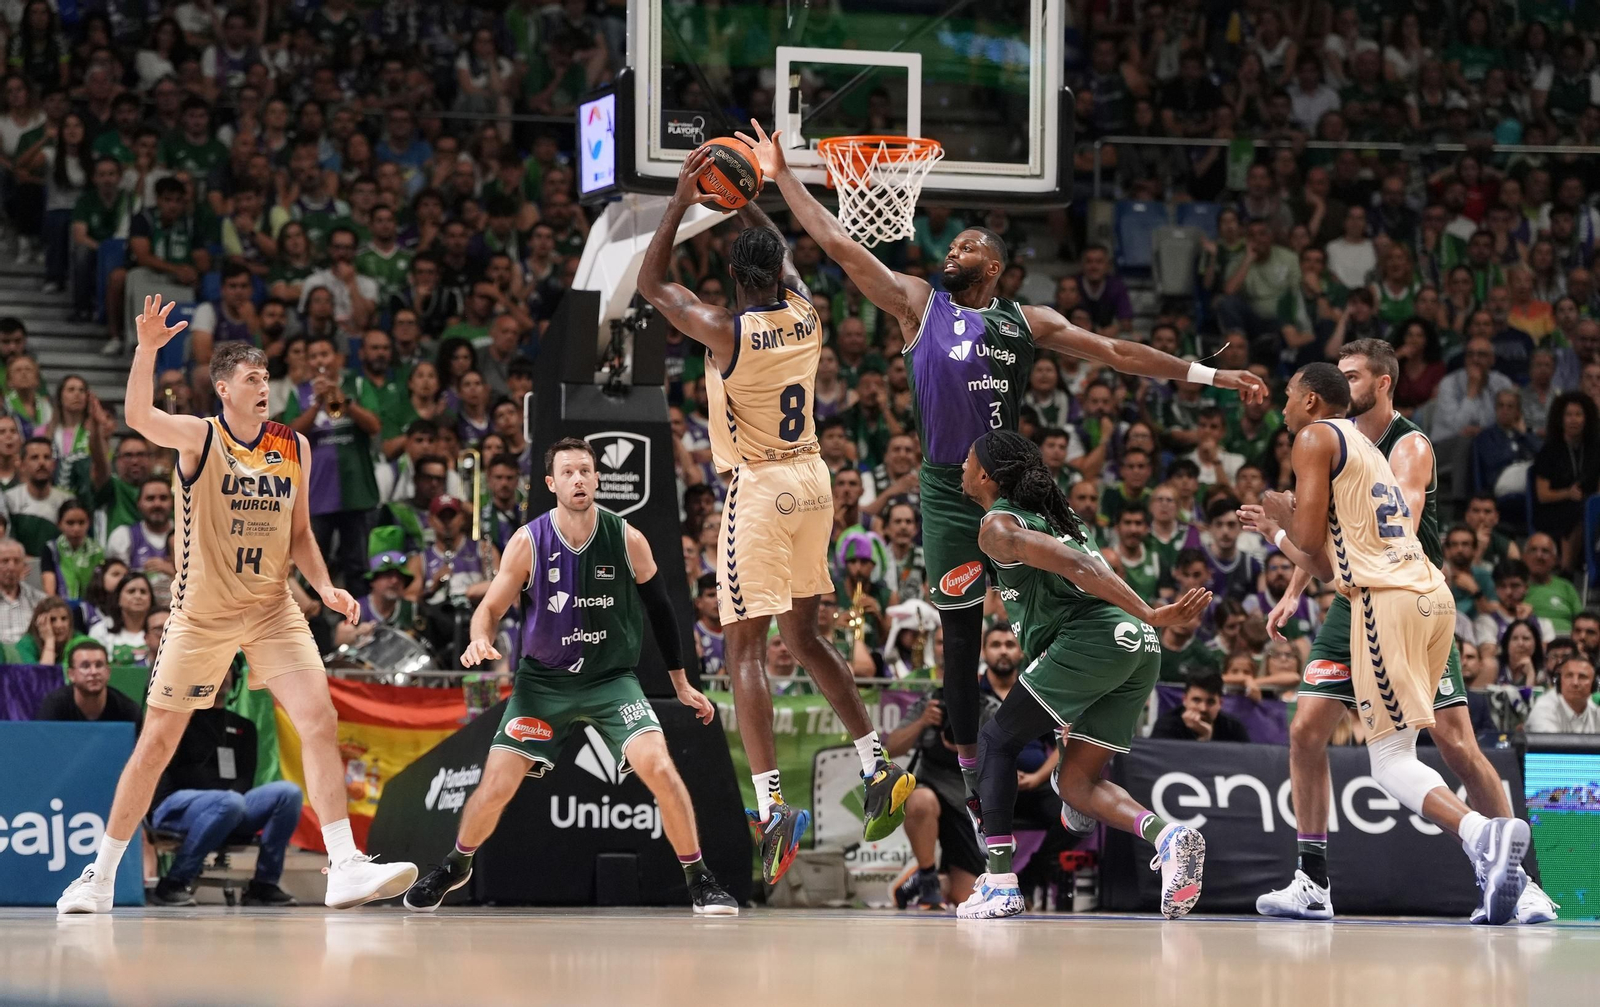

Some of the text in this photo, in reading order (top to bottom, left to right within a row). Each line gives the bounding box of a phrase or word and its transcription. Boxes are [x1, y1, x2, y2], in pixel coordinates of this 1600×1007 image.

[668, 126, 699, 135] PLAYOFF
[751, 314, 817, 351] SANT-ROO
[968, 374, 1009, 393] málag
[778, 383, 806, 443] 8
[989, 401, 1003, 430] 3
[221, 474, 292, 498] UCAM
[599, 472, 640, 482] undación
[601, 482, 634, 493] Unicaja
[231, 499, 281, 512] MURCIA
[236, 547, 263, 575] 14
[946, 564, 982, 592] famadesa
[561, 627, 607, 646] málaga
[510, 720, 551, 738] famadesa
[551, 795, 662, 839] Unicaj
[0, 798, 105, 872] aja
[843, 843, 912, 867] Unicaj
